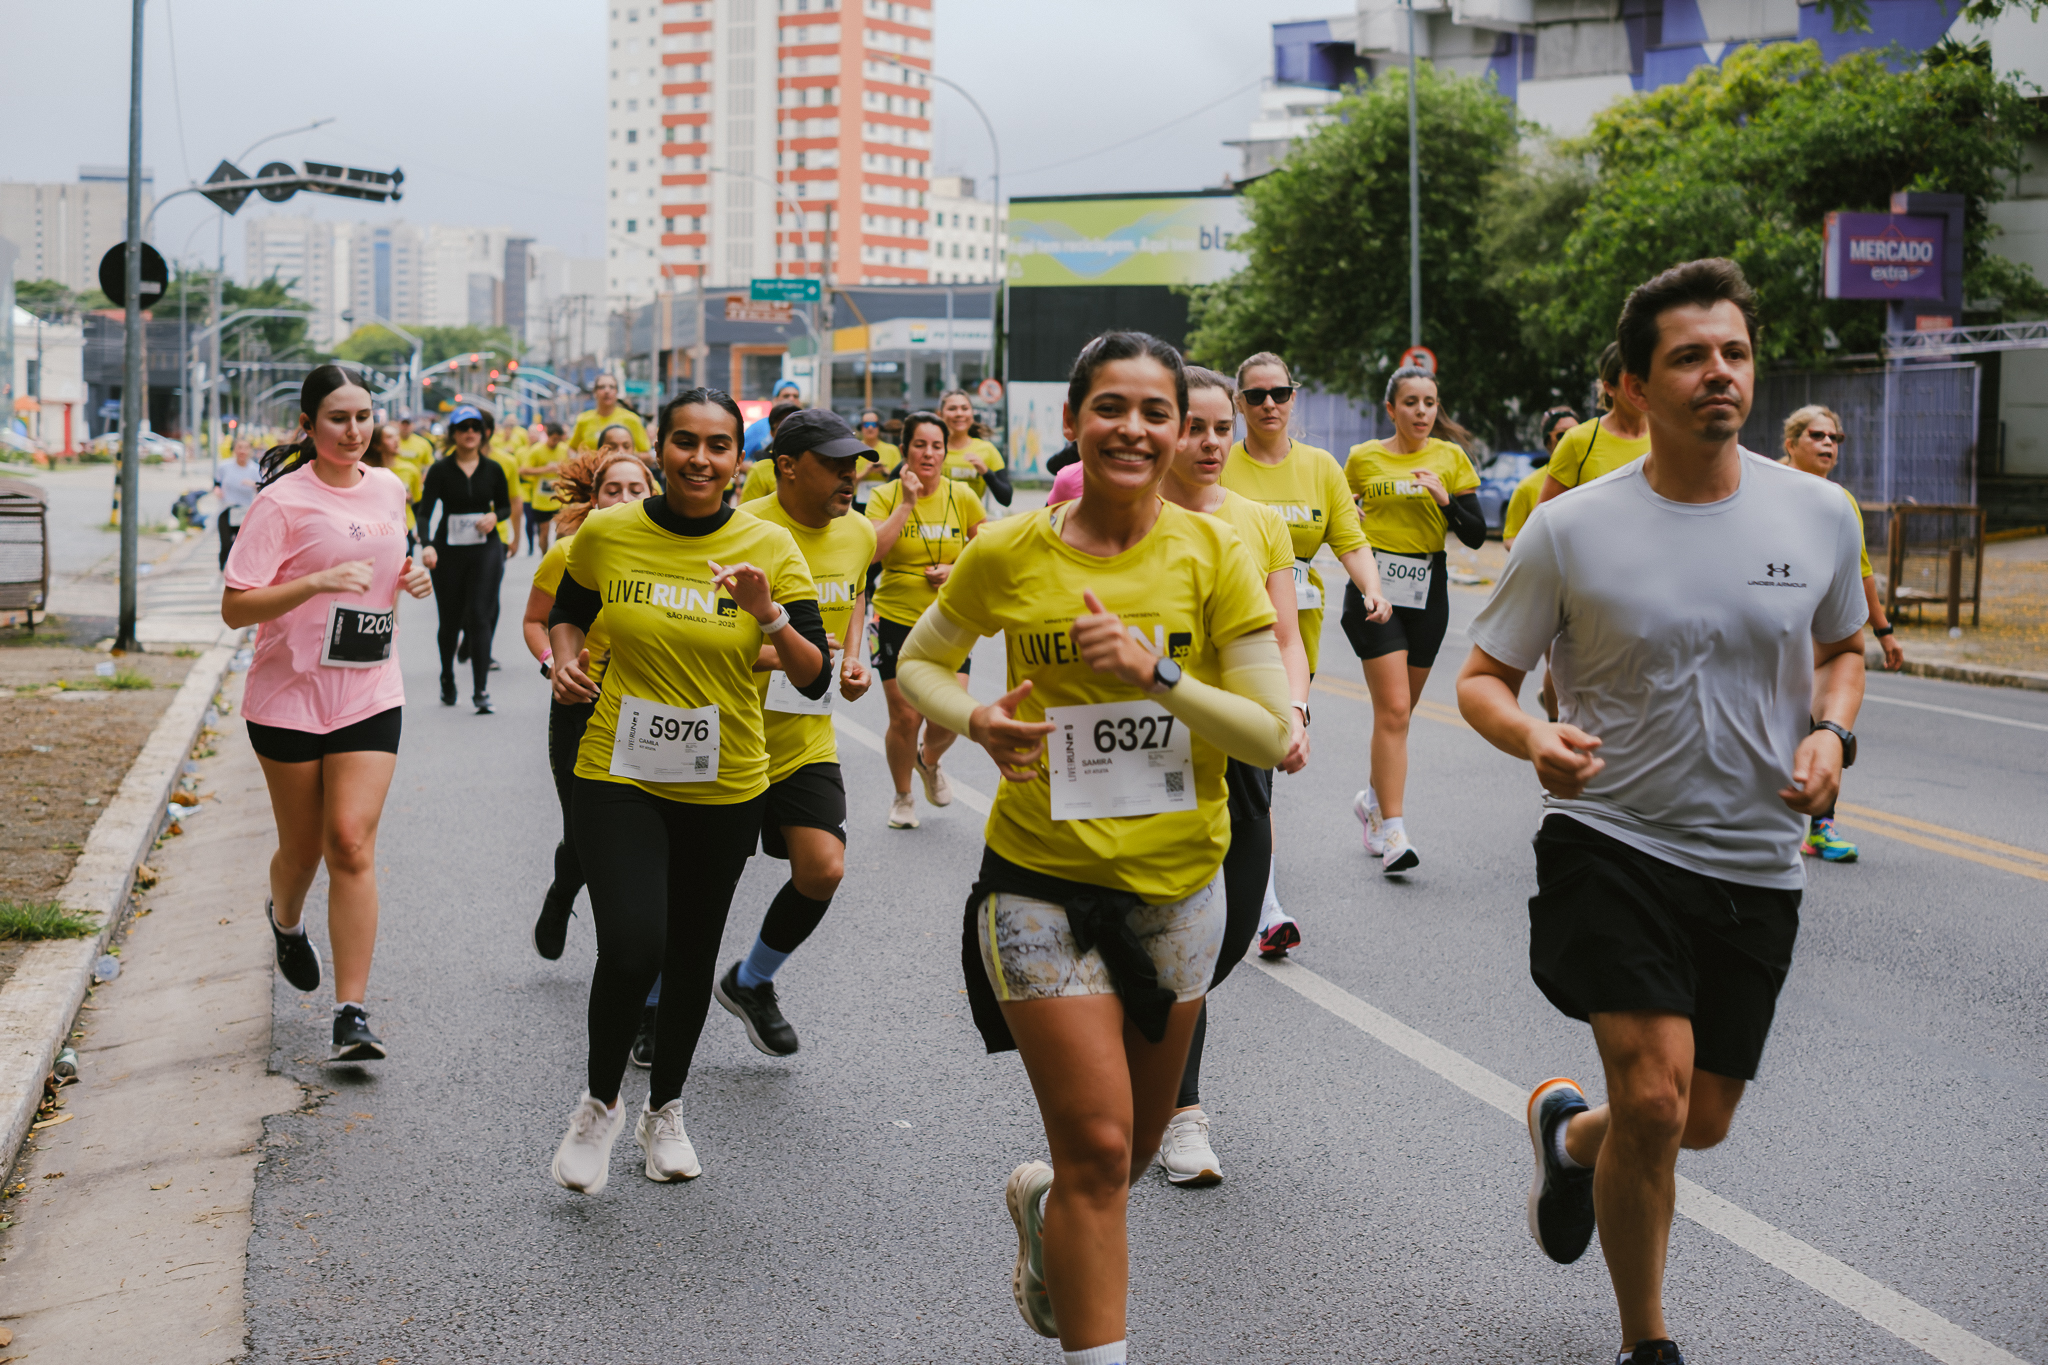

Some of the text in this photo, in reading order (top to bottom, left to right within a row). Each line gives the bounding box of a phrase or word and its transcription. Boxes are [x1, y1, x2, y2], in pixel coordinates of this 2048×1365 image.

[1850, 239, 1933, 262] MERCADO
[1871, 265, 1908, 281] extra
[366, 523, 396, 537] UBS
[1293, 567, 1302, 584] 71
[1387, 562, 1426, 581] 5049
[357, 613, 392, 634] 1203
[666, 611, 682, 620] SÃO
[684, 614, 707, 624] PAULO
[718, 620, 736, 628] 2025
[649, 714, 709, 741] 5976
[1094, 715, 1174, 753] 6327
[639, 738, 659, 747] CAMILA
[1082, 758, 1113, 767] SAMIRA
